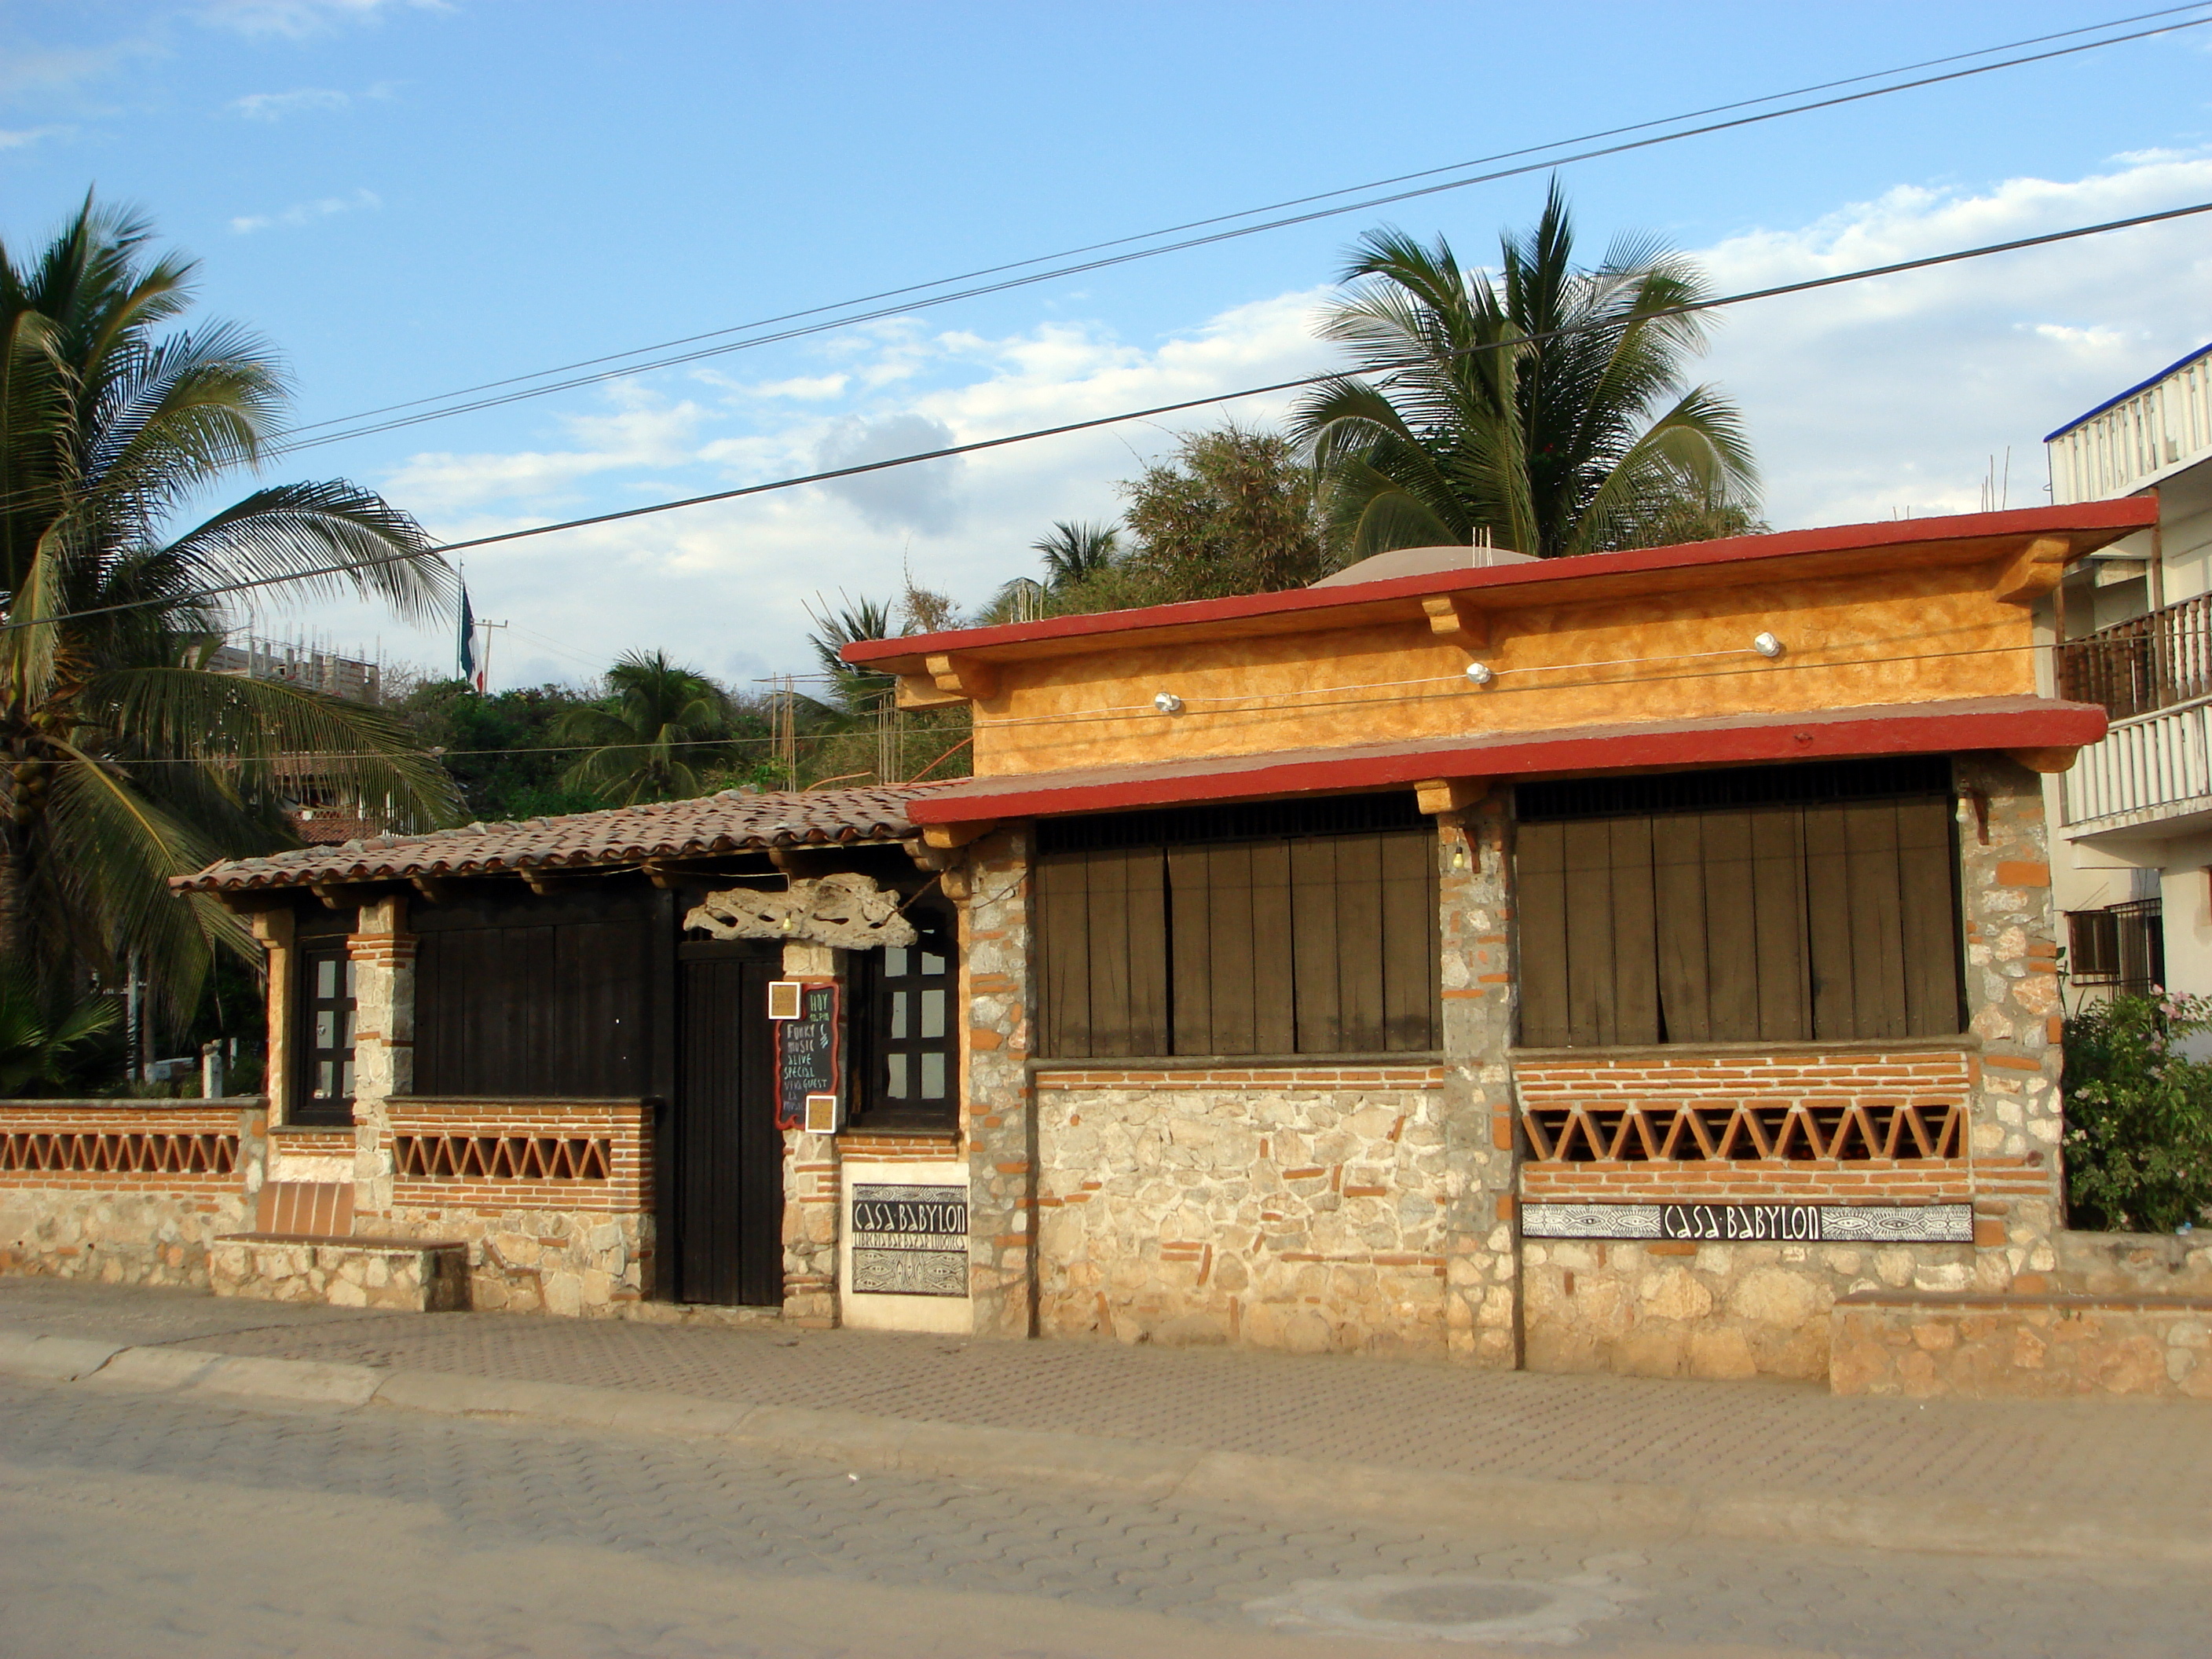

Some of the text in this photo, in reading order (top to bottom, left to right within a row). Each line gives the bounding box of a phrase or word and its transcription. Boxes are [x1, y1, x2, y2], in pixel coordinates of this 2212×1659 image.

[810, 994, 828, 1012] HOY
[787, 1024, 815, 1041] FUNKY
[787, 1039, 815, 1053] MUSIC
[784, 1066, 815, 1080] SPECIAL
[803, 1078, 828, 1092] GUEST
[855, 1203, 965, 1233] CASA BABYLON
[1664, 1205, 1819, 1240] CASA BABYLON
[888, 1233, 903, 1248] BAR
[904, 1233, 929, 1249] BAZAR
